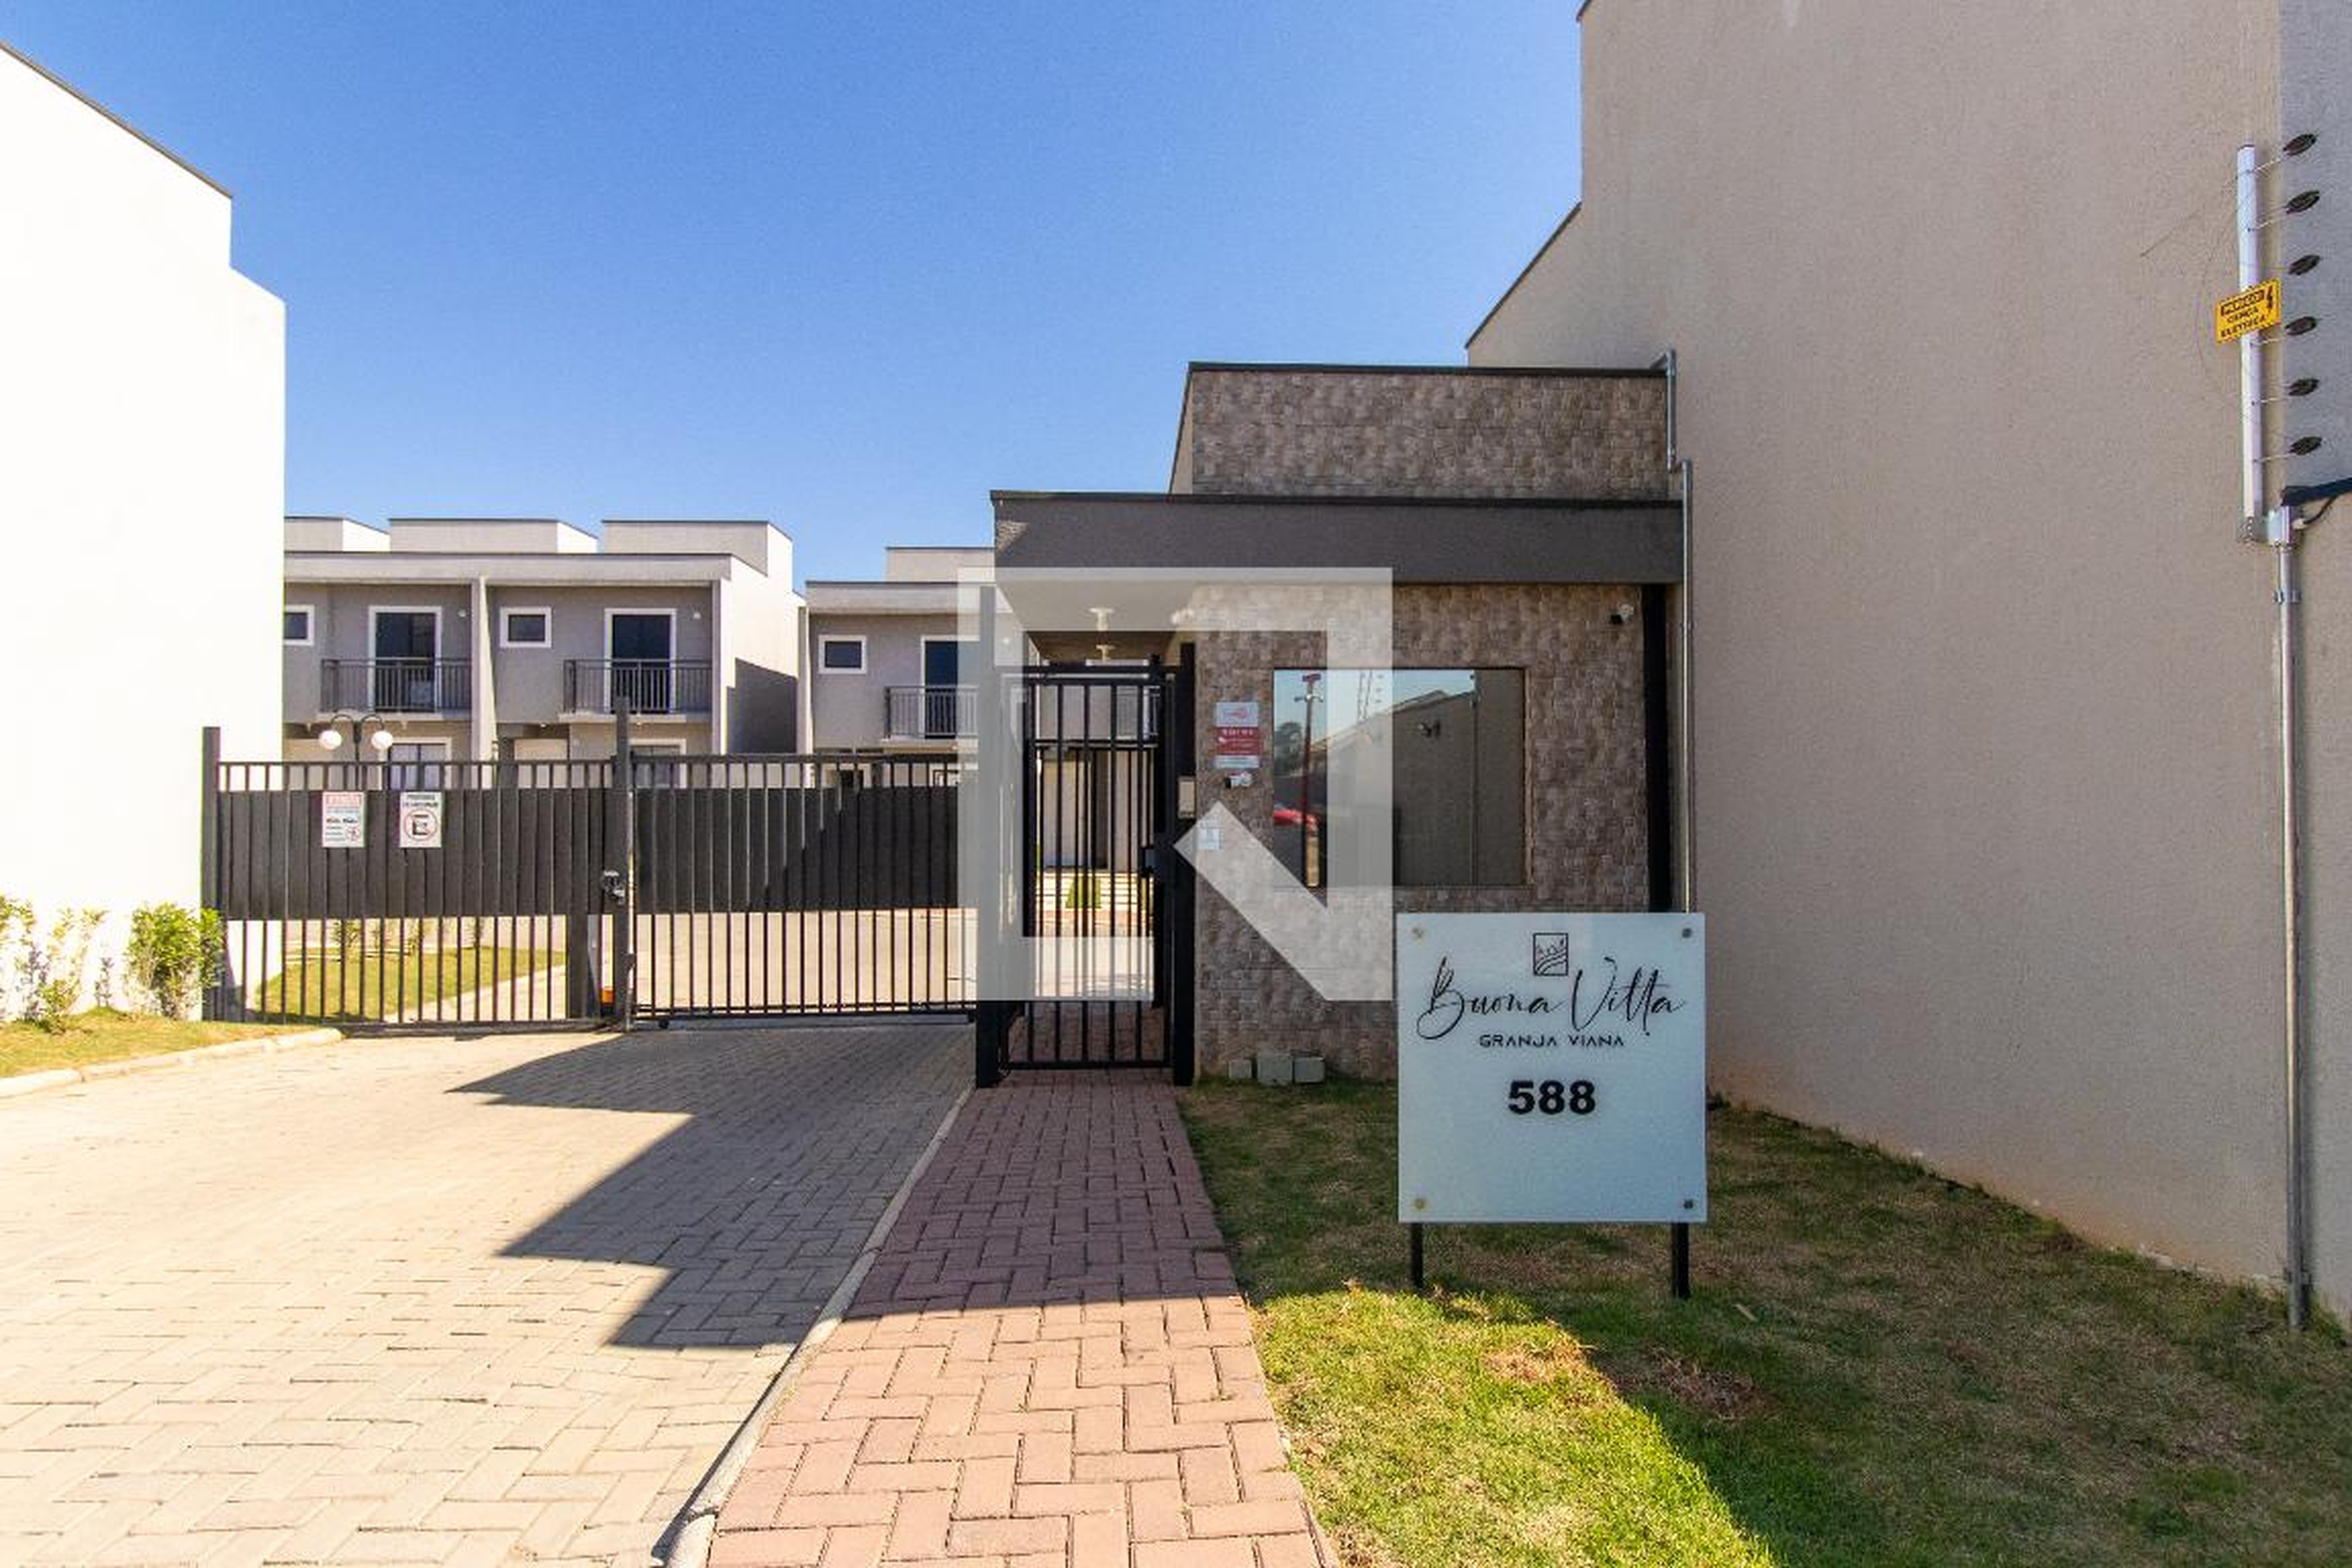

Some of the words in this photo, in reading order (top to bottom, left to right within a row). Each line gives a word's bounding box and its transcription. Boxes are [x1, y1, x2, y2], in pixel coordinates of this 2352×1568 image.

[1417, 956, 1565, 1040] Buona
[1571, 957, 1686, 1036] Vitta
[1479, 1034, 1558, 1048] GRANJA
[1568, 1034, 1625, 1048] VIANA
[1508, 1080, 1596, 1115] 588
